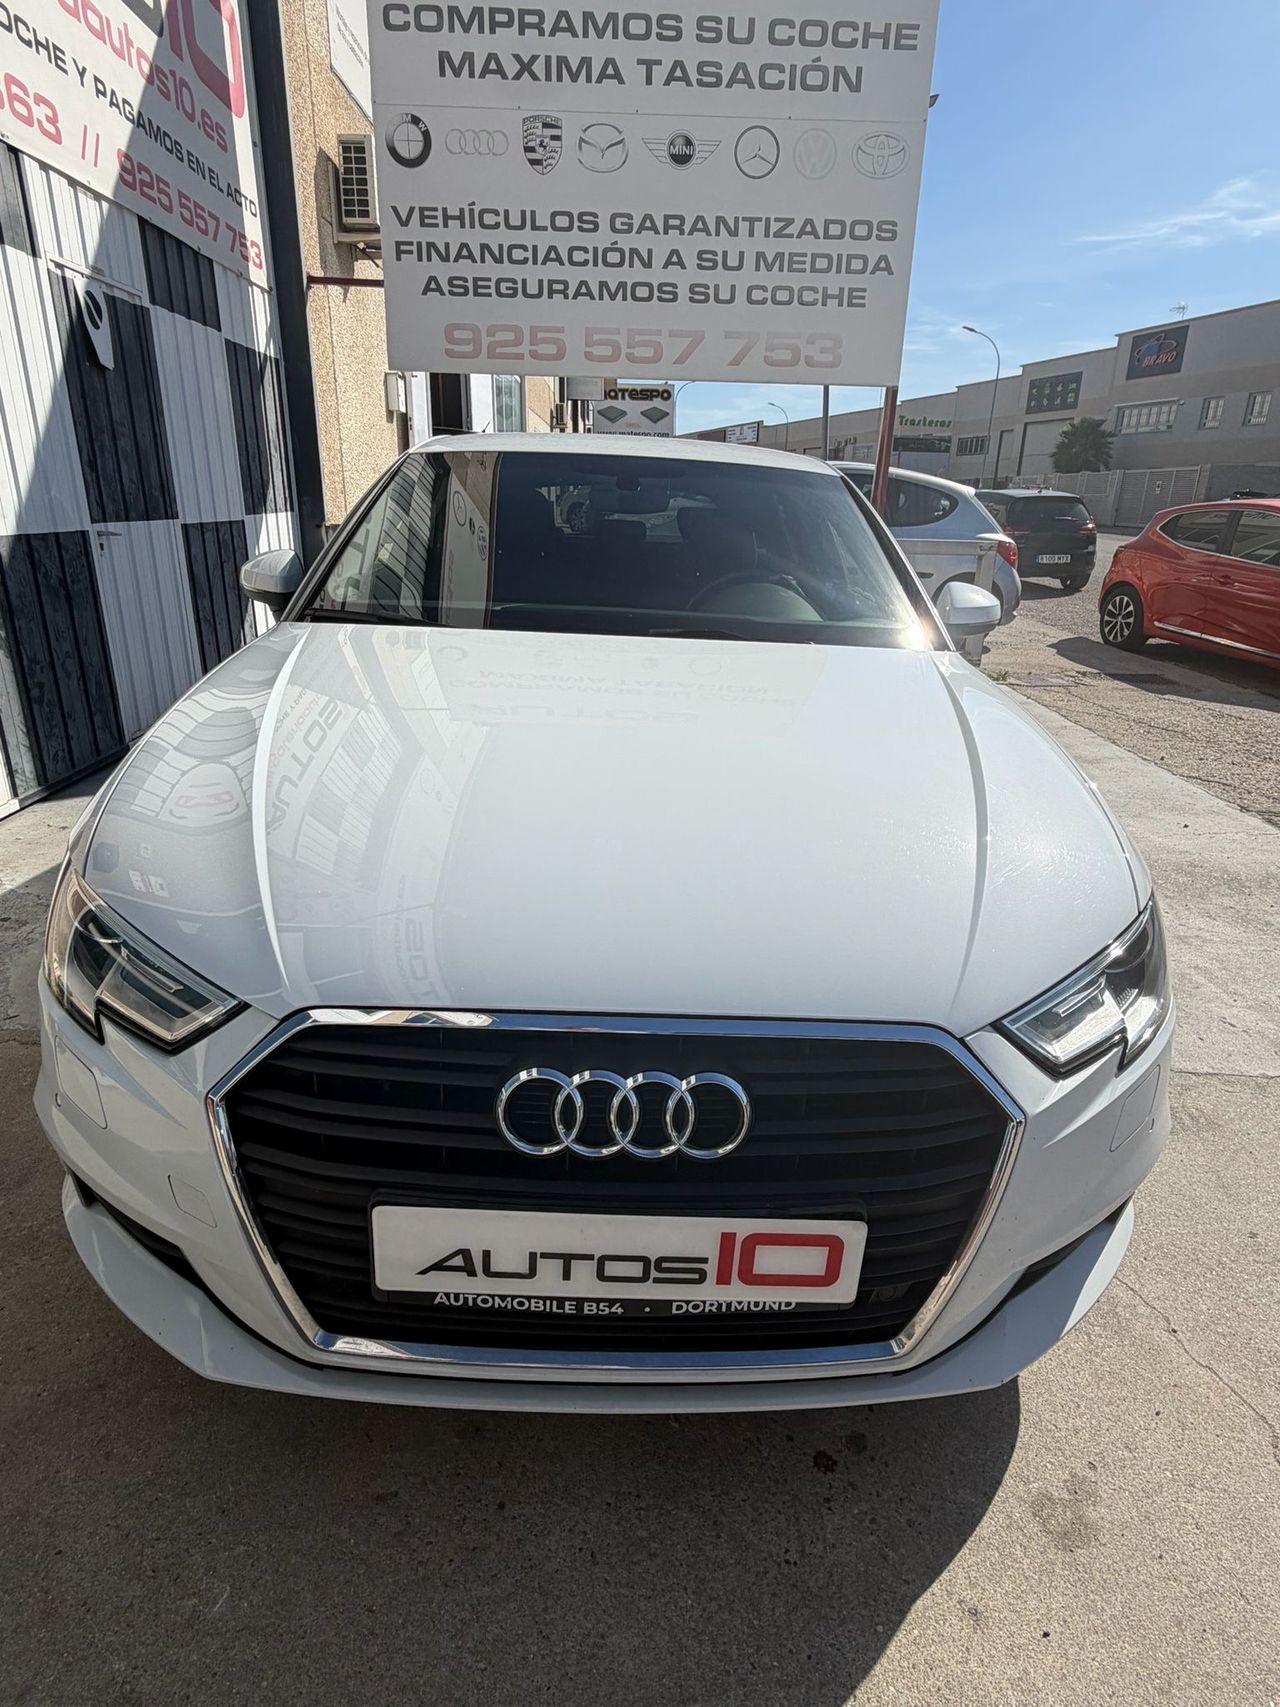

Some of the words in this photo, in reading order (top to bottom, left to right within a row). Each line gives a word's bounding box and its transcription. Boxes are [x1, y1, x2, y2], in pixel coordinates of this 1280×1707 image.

[383, 3, 683, 42] COMPRAMOS
[695, 15, 756, 45] SU
[768, 18, 921, 51] COCHE
[438, 50, 626, 86] MAXIMA
[636, 56, 864, 93] TASACIÓN
[71, 56, 87, 88] Y
[93, 74, 184, 163] PAGAMOS
[188, 149, 206, 182] EN
[208, 166, 224, 193] EL
[226, 182, 258, 218] ACTO
[669, 145, 693, 155] MINI
[0, 72, 62, 145] 63
[117, 148, 173, 214] 925
[177, 188, 220, 242] 557
[225, 222, 263, 270] 753
[391, 201, 600, 233] VEHÍCULOS
[609, 212, 898, 242] GARANTIZADOS
[394, 240, 653, 269] FINANCIACIÓN
[662, 248, 687, 270] A
[696, 249, 745, 272] SU
[754, 250, 895, 276] MEDIDA
[421, 275, 679, 303] ASEGURAMOS
[688, 283, 737, 305] SU
[746, 284, 868, 308] COCHE
[444, 323, 567, 362] 925
[583, 326, 706, 366] 557
[724, 330, 844, 369] 753
[1142, 351, 1177, 367] BRAVO
[415, 1231, 846, 1288] AUTOS10
[434, 1291, 577, 1314] AUTOMOBILE
[583, 1301, 624, 1316] B54
[671, 1300, 797, 1314] DORTMUND
